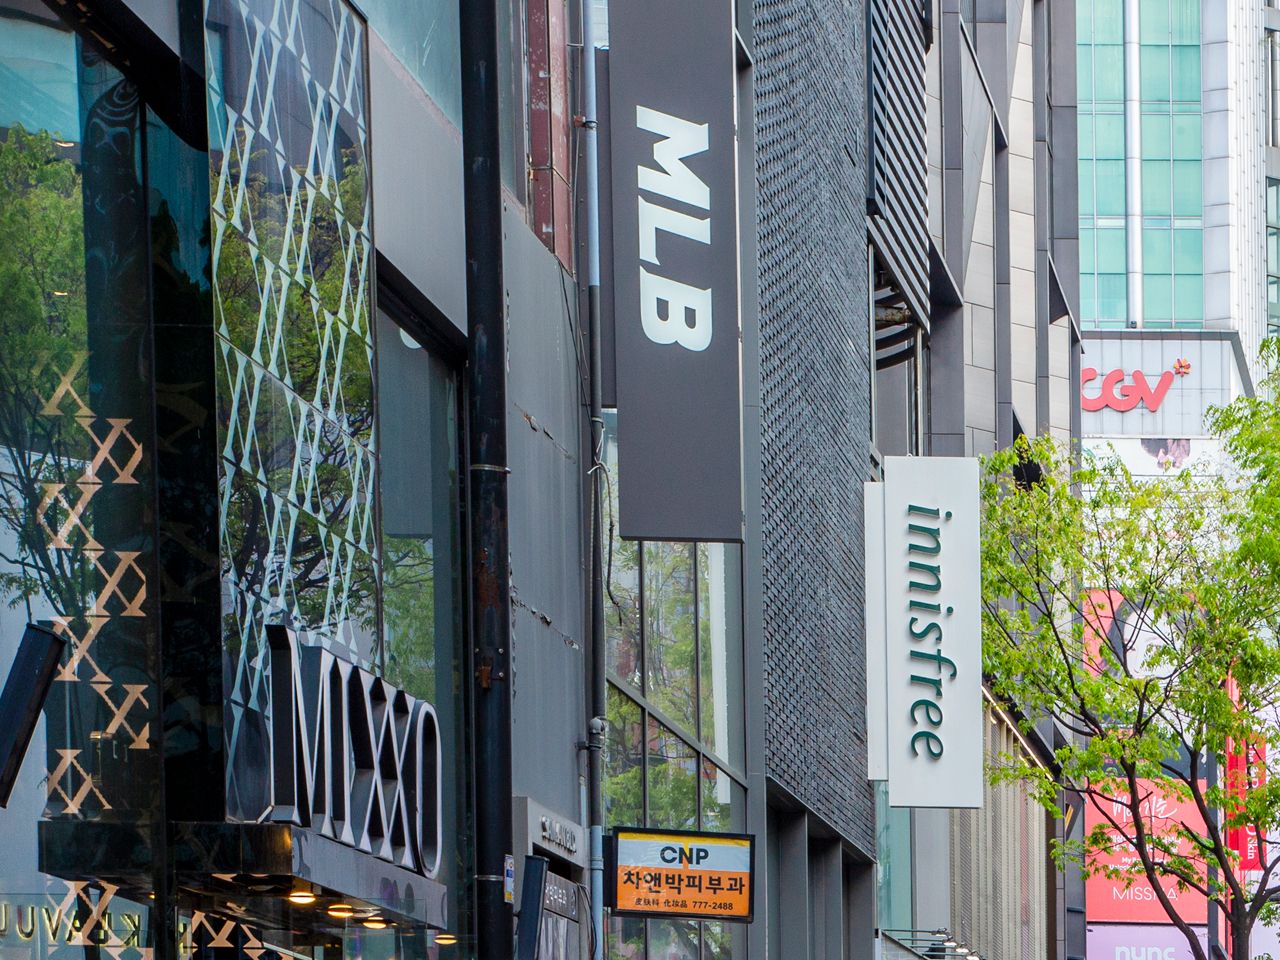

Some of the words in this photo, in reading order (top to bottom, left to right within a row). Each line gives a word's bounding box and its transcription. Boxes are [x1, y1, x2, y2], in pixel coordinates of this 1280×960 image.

[636, 105, 713, 351] MLB
[1082, 368, 1174, 412] CGV
[908, 503, 957, 761] innisfree
[267, 625, 442, 880] MIXXO
[660, 846, 709, 864] CNP
[623, 871, 745, 895] 차앤박피부과
[692, 901, 734, 911] 777-2488
